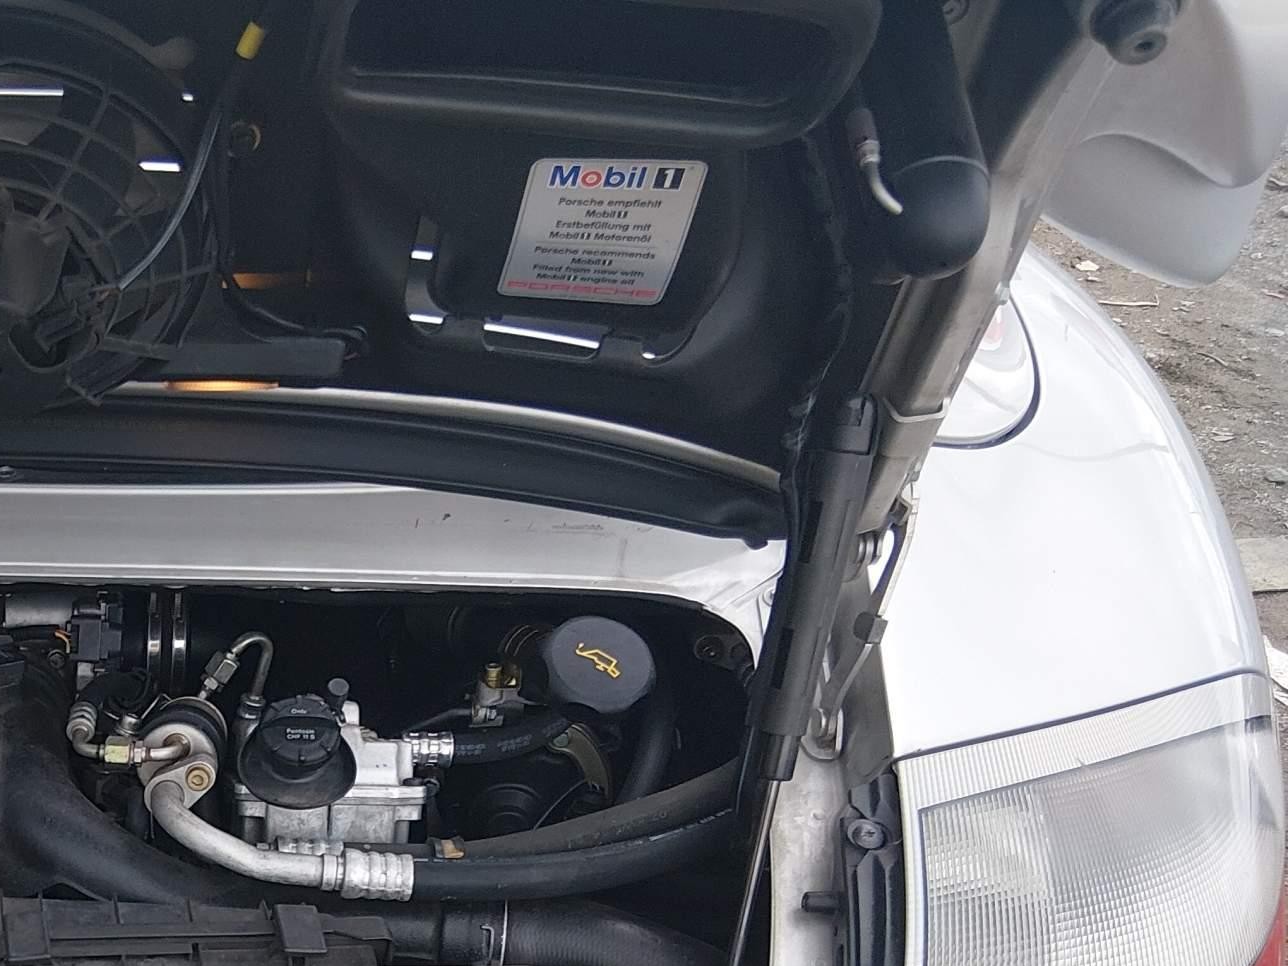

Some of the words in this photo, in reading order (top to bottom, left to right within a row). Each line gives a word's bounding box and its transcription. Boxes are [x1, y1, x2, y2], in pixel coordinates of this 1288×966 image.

[548, 164, 648, 188] Mobil
[558, 197, 604, 207] Porsche
[607, 199, 662, 209] empfiehlt
[584, 210, 616, 218] Mobil
[556, 220, 629, 232] Erstbefüllung
[632, 222, 652, 232] mit
[549, 231, 580, 240] Mobil
[593, 232, 652, 243] Motorenöl
[534, 246, 580, 256] Porsche
[582, 248, 656, 260] recommends
[570, 257, 601, 266] Mobil
[564, 266, 591, 274] from
[594, 268, 618, 276] new
[620, 270, 646, 278] with
[536, 272, 565, 281] Mobil
[580, 276, 619, 285] engine
[620, 277, 636, 286] oil
[508, 280, 657, 298] PORSCHE
